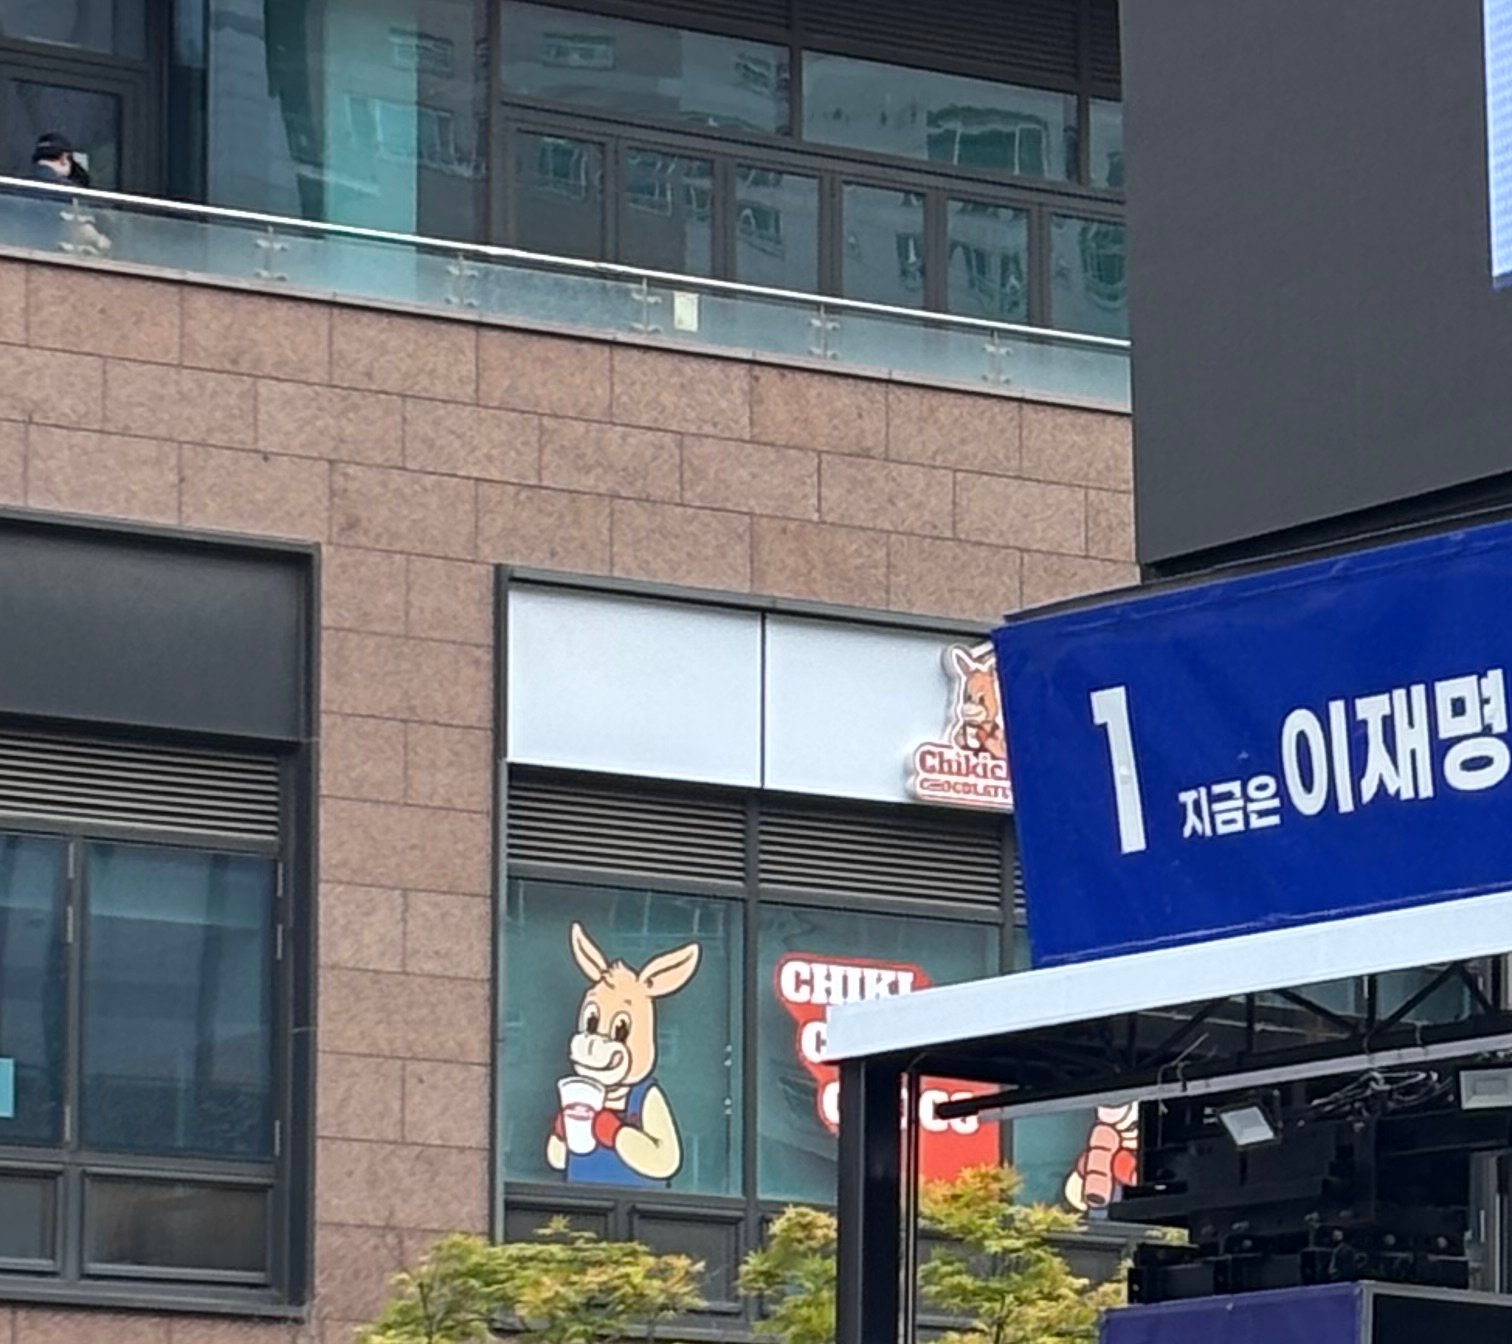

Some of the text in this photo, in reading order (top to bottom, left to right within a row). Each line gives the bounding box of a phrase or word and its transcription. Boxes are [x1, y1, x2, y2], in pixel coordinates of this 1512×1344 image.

[919, 749, 1010, 781] Chikic
[1090, 668, 1511, 854] 1 지금은 이재명
